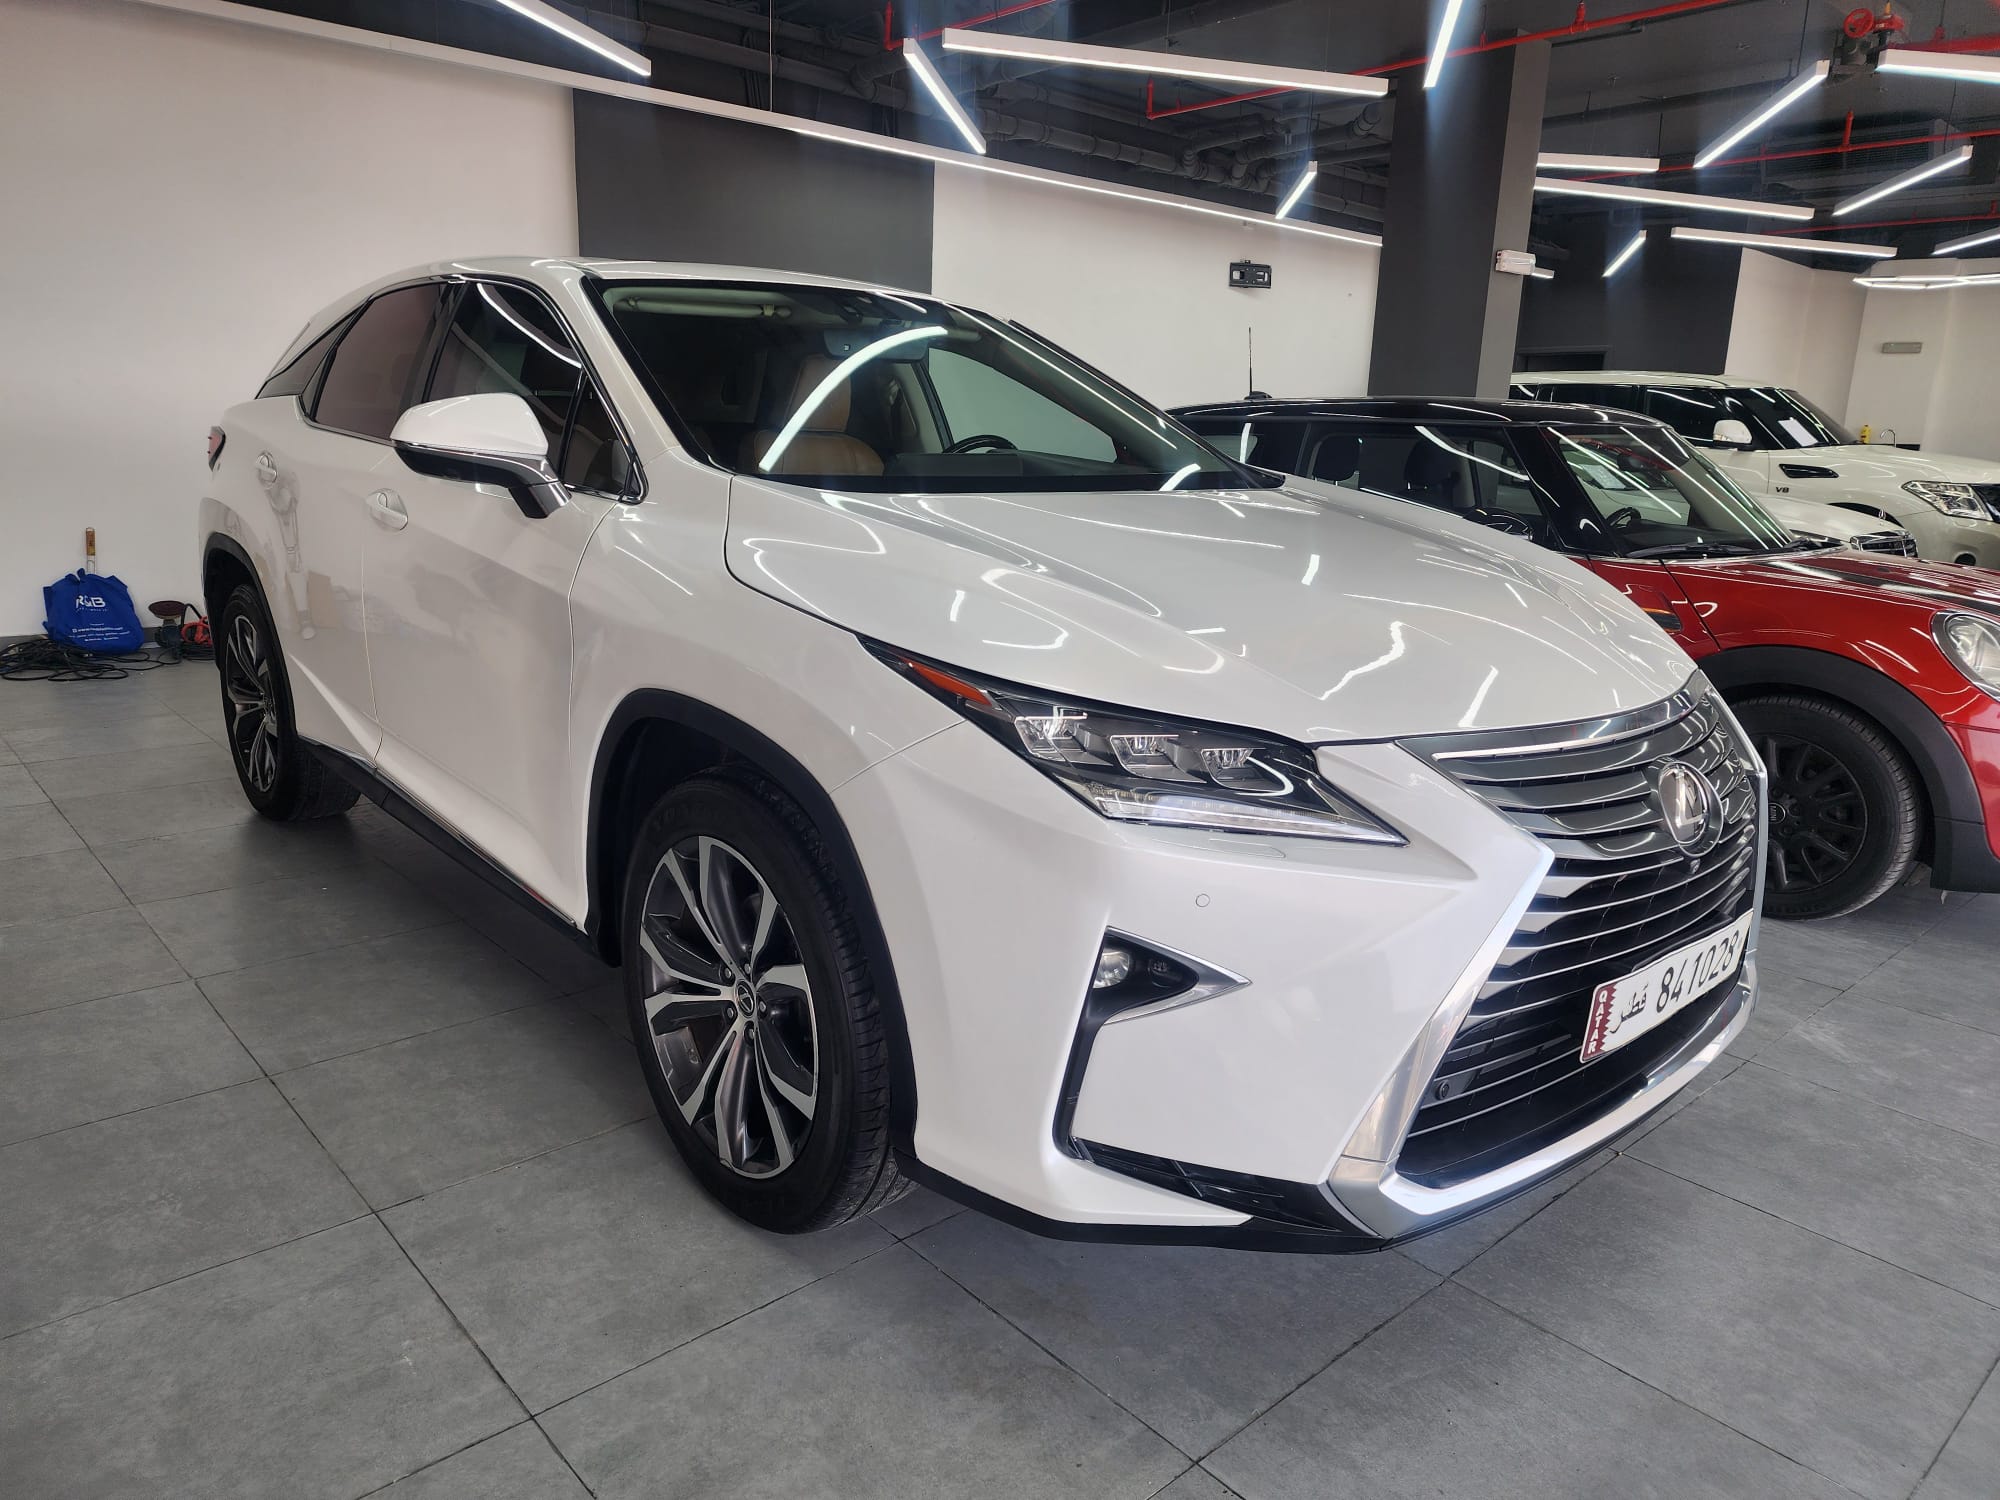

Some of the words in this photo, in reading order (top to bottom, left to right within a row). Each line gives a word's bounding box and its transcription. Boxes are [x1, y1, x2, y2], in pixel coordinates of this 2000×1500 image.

[1775, 486, 1790, 494] V8
[1656, 930, 1740, 1014] 841028
[1587, 989, 1608, 1054] QATAR
[1609, 983, 1649, 1034] قطر
